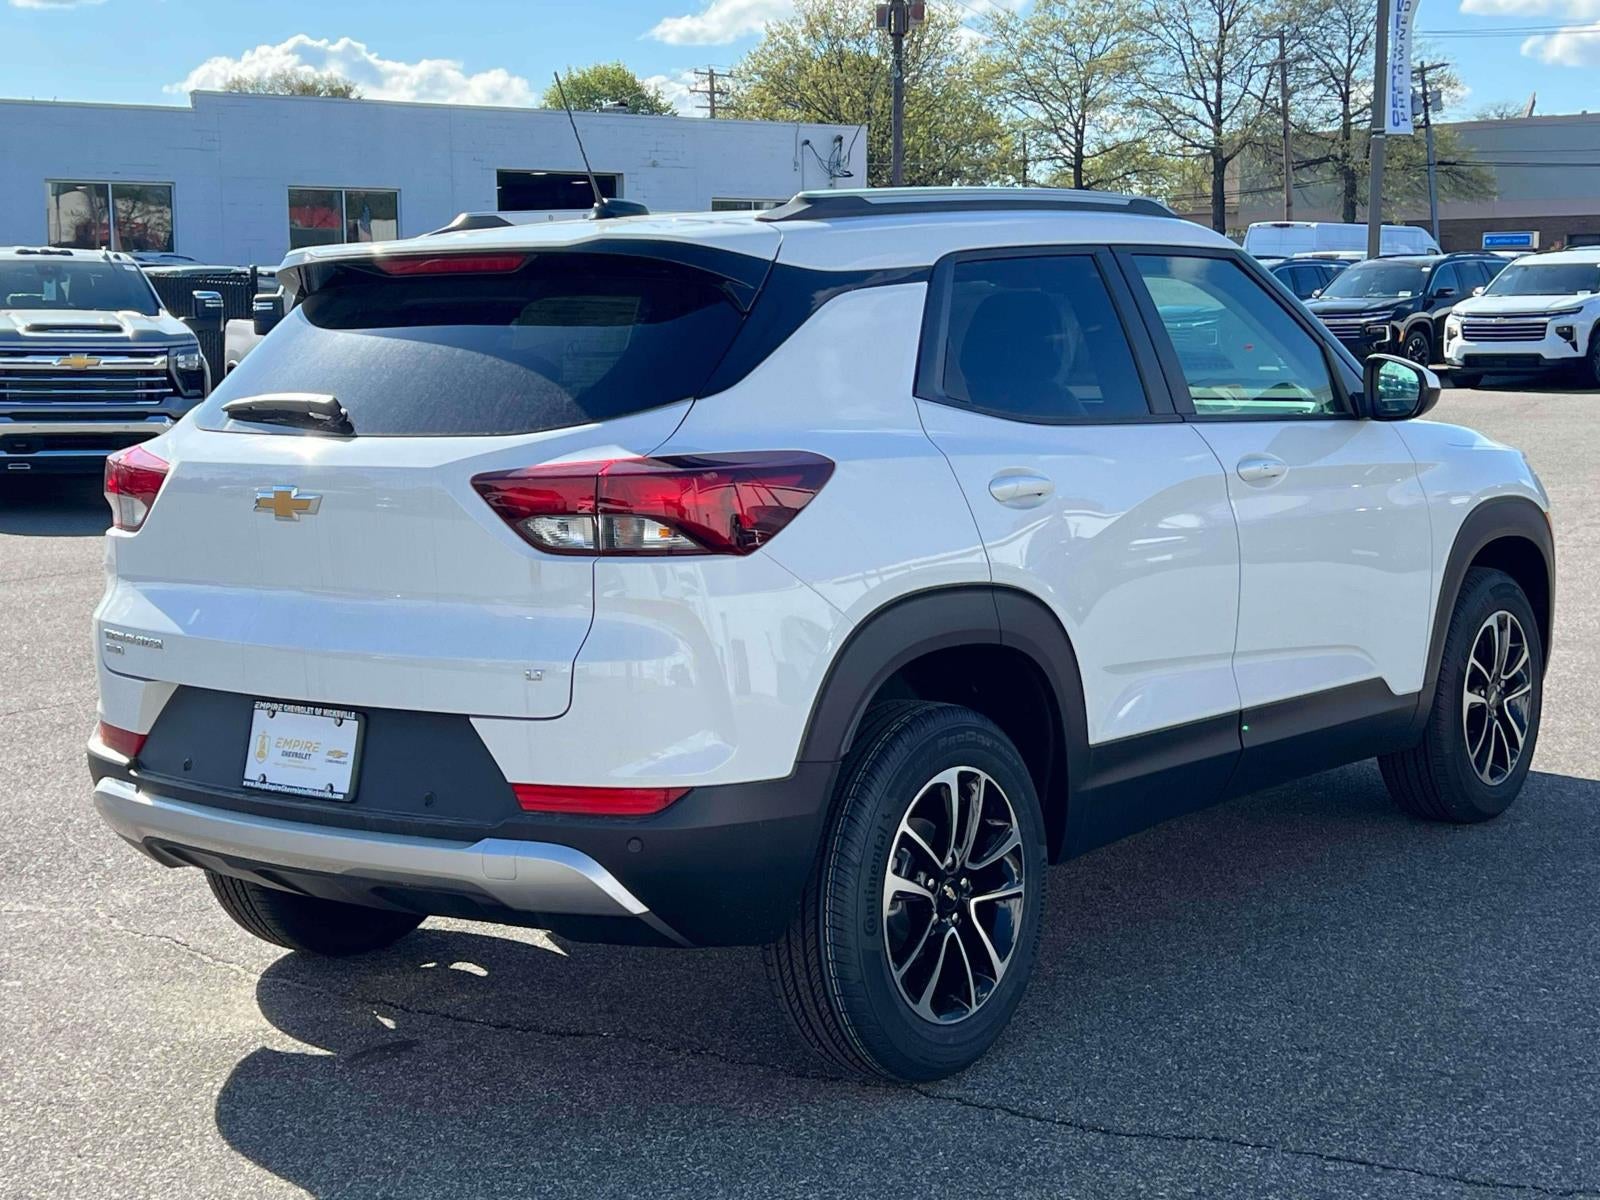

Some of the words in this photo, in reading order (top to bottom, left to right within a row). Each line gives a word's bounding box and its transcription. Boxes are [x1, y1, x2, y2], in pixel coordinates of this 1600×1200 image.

[1392, 0, 1404, 128] CERTED
[525, 669, 545, 681] LT
[254, 701, 284, 712] EMPIRE
[283, 705, 315, 715] CHEVROLET
[315, 707, 323, 716] OF
[323, 708, 356, 720] HICKSVILLE
[275, 737, 322, 753] EMPIRE
[281, 750, 312, 760] CHEVROLET
[863, 824, 888, 937] Continental
